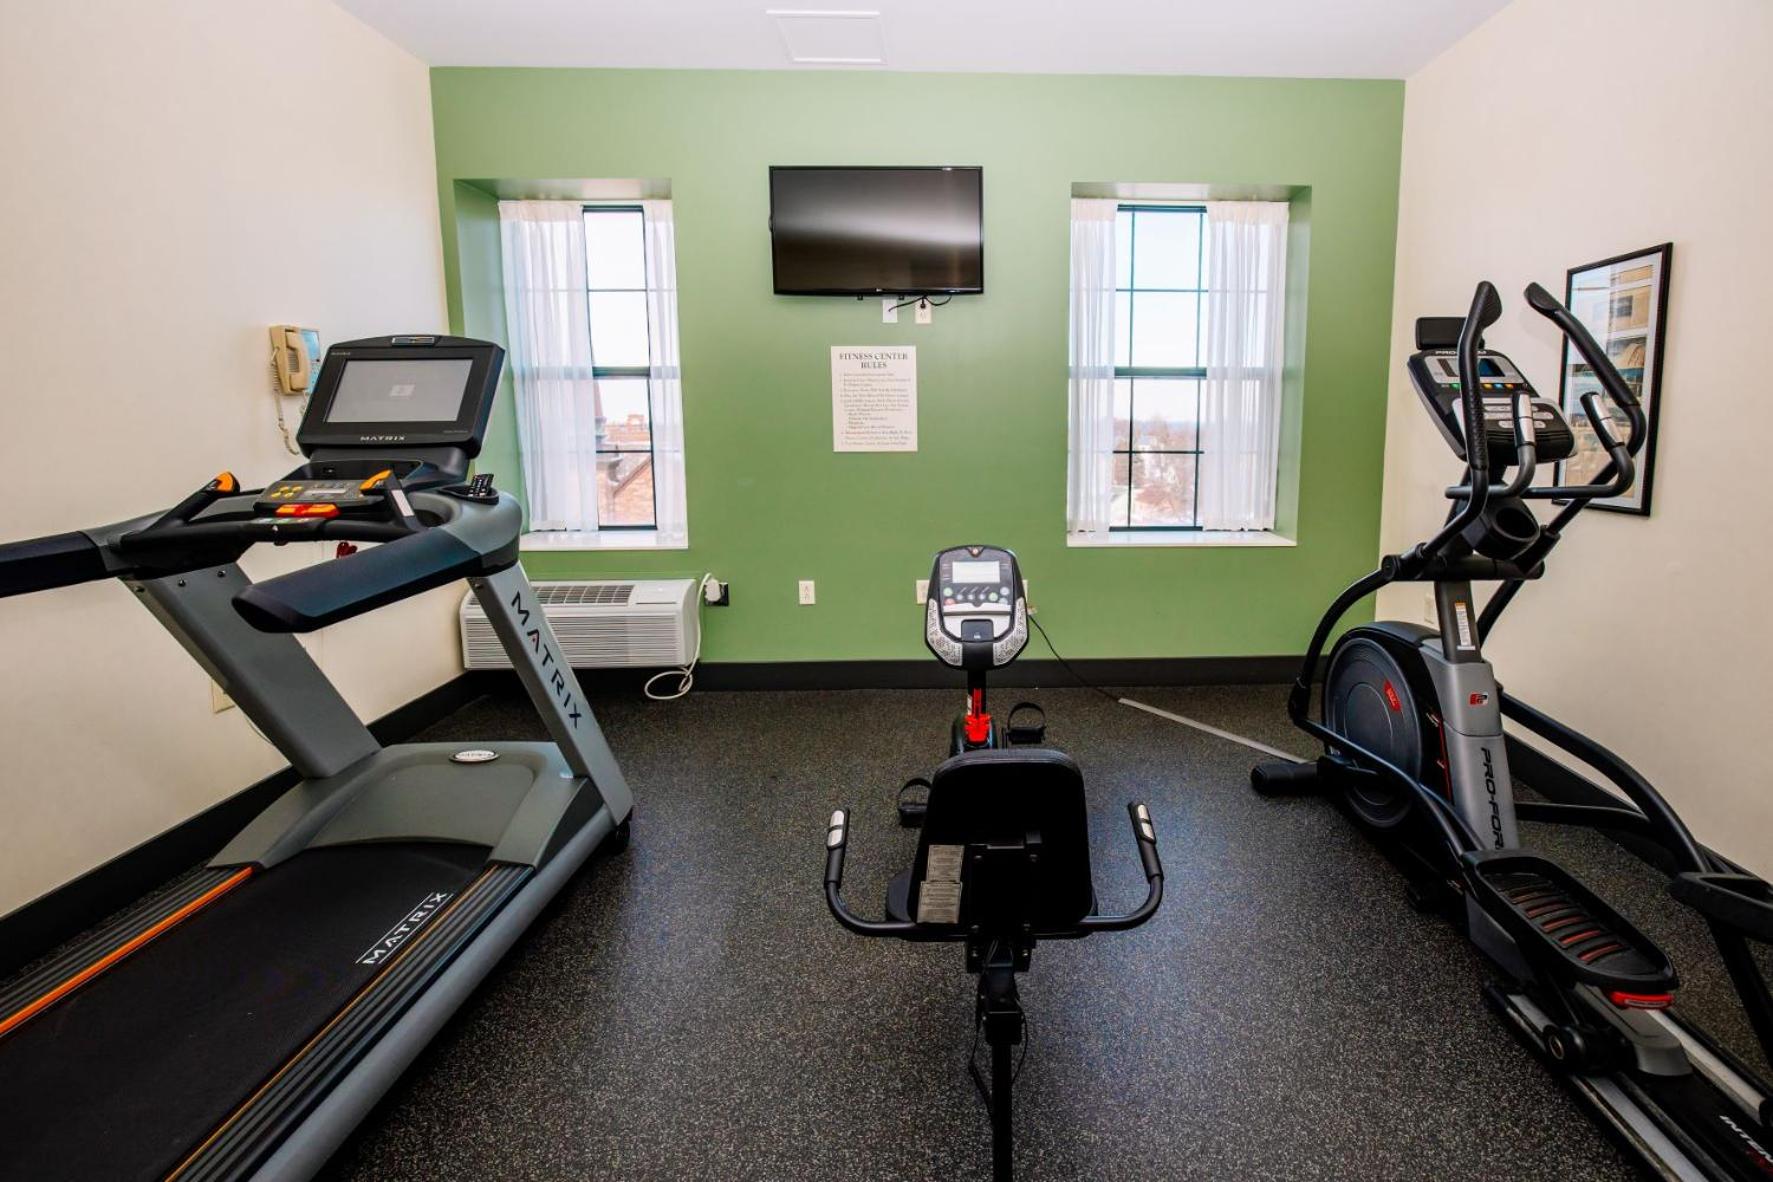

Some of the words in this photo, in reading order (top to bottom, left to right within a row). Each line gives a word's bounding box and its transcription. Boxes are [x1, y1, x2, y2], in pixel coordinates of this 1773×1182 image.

[839, 352, 873, 360] FITNESS
[874, 352, 908, 360] CENTER
[861, 361, 887, 369] RULES
[511, 590, 582, 729] MATRIX
[362, 892, 447, 965] MATRIX
